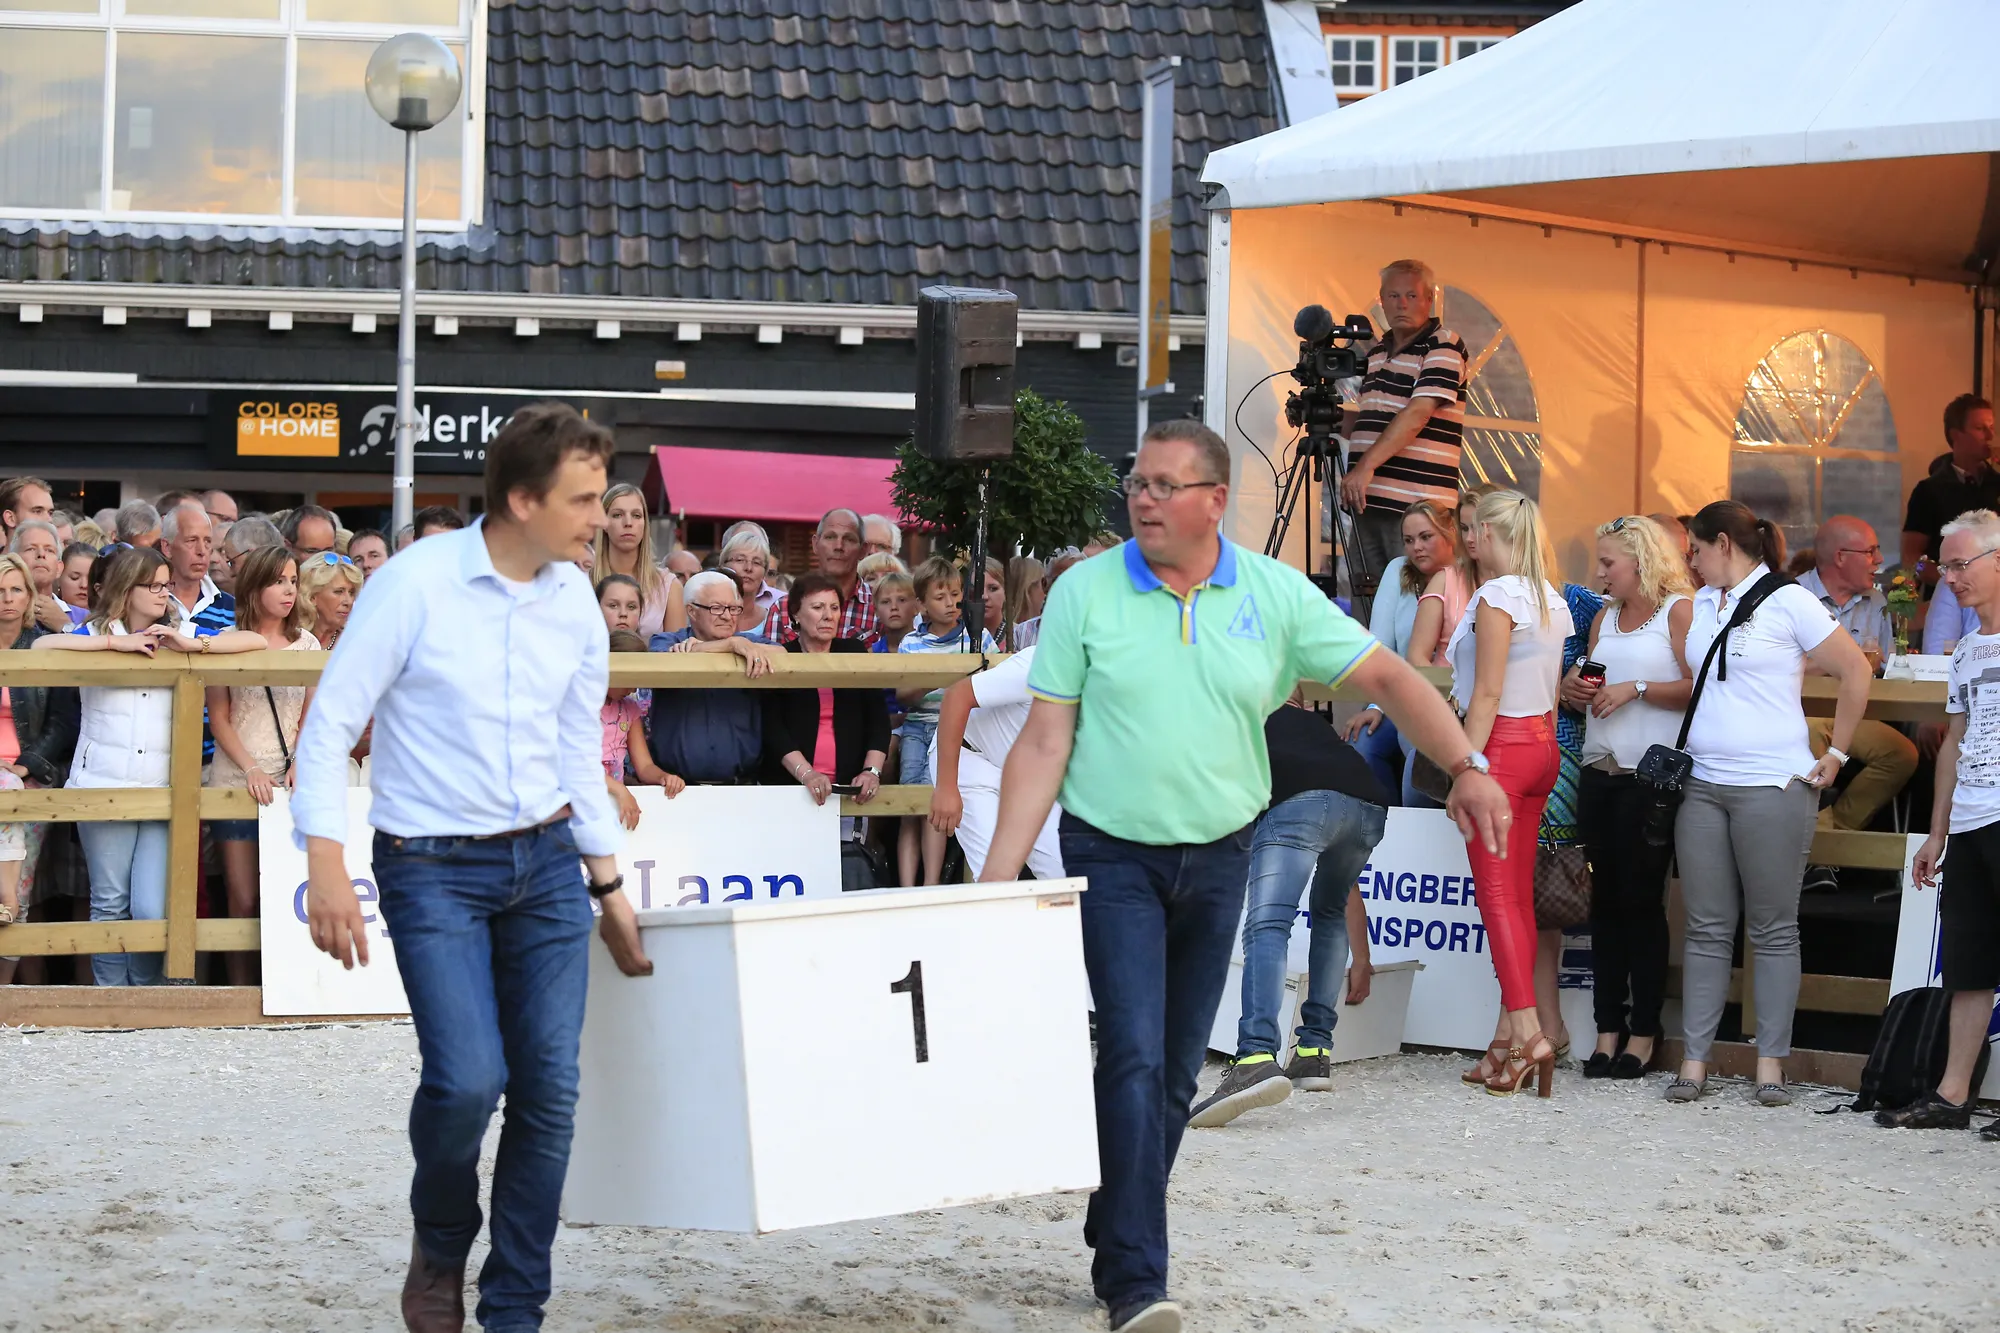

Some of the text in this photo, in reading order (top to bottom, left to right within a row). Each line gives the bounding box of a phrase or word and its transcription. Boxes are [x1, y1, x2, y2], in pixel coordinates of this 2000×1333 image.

[239, 401, 338, 418] COLORS
[260, 418, 337, 437] HOME
[890, 960, 928, 1063] 1
